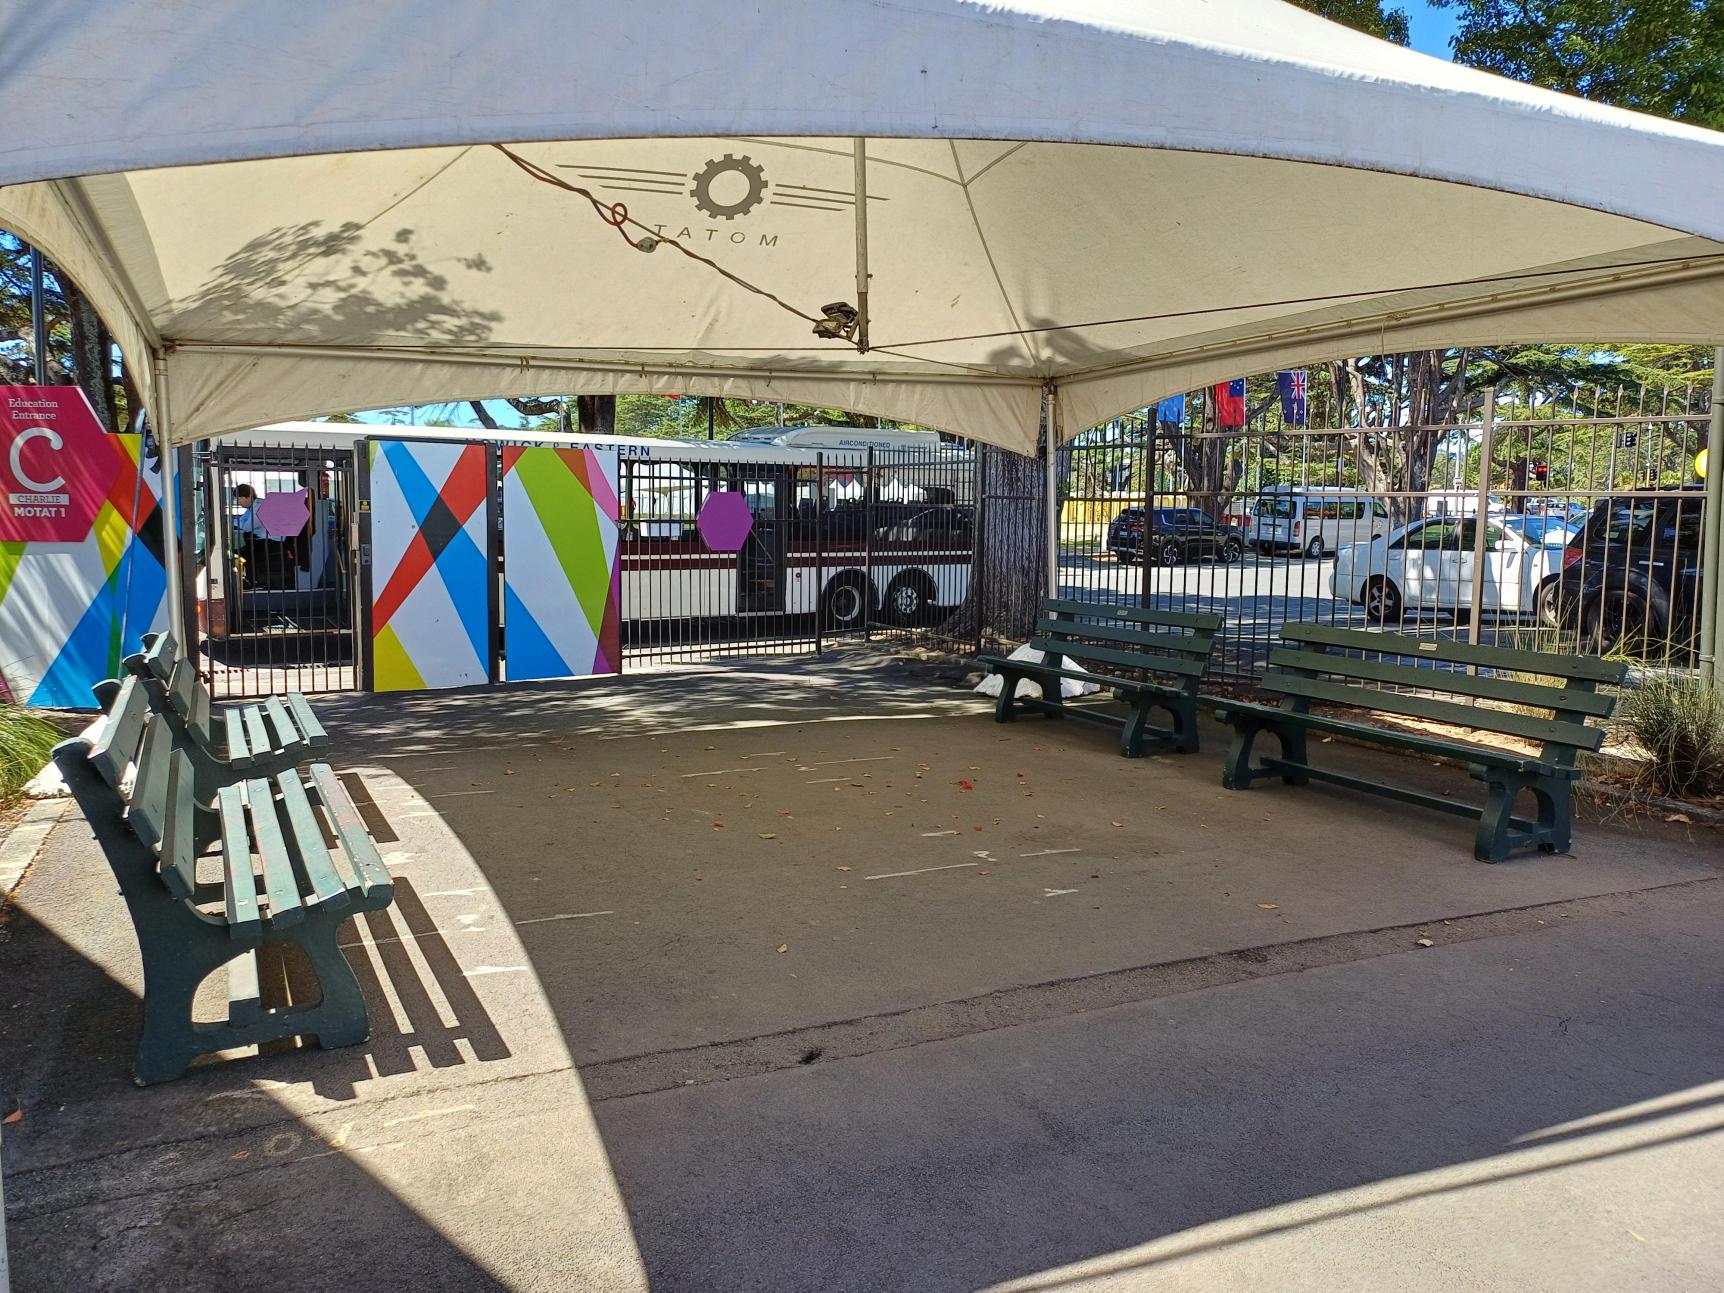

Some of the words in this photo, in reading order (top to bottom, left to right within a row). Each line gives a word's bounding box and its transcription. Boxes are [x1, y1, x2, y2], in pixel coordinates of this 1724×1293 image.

[8, 398, 59, 408] Education
[11, 410, 57, 420] Entrance
[839, 439, 891, 449] AIRCONDITIONED
[9, 427, 66, 492] C
[17, 495, 62, 504] CHARLIE
[14, 507, 58, 517] MOTAT
[60, 507, 66, 517] 1
